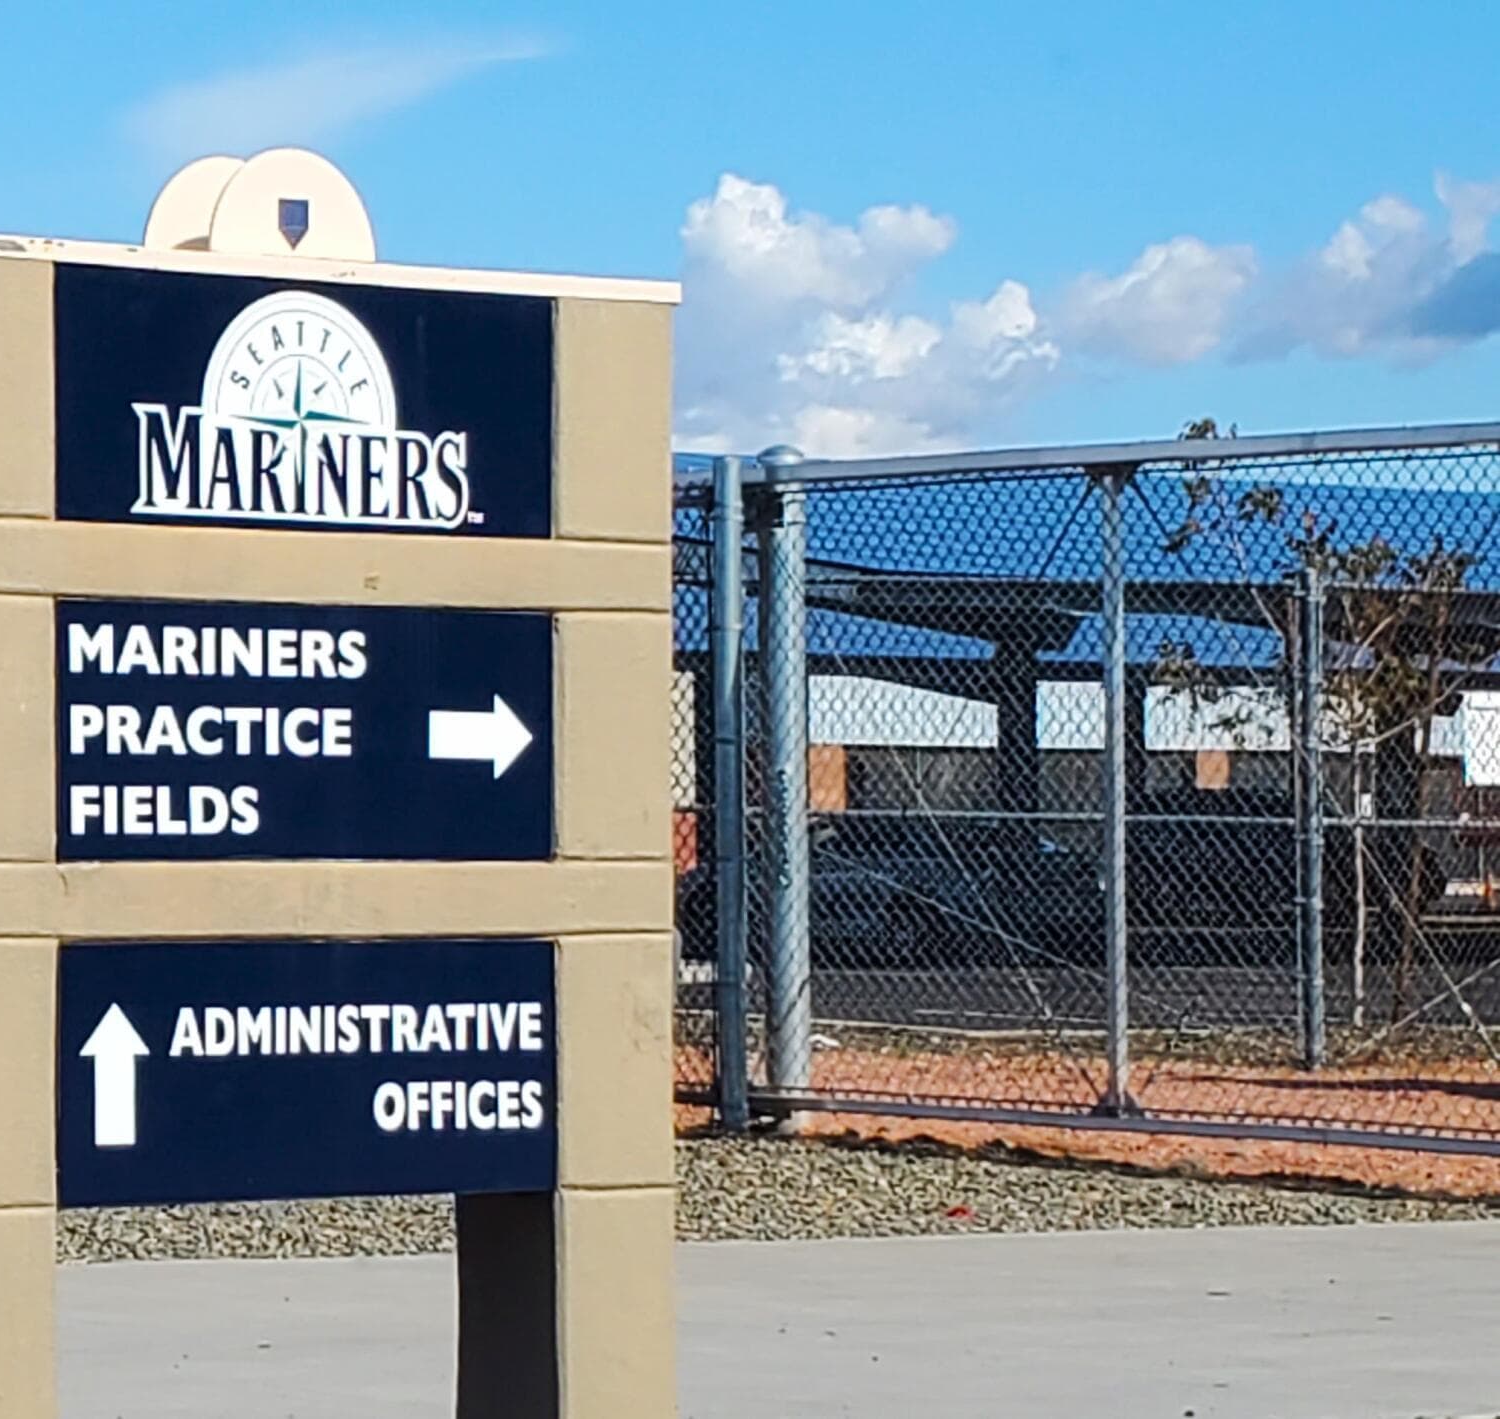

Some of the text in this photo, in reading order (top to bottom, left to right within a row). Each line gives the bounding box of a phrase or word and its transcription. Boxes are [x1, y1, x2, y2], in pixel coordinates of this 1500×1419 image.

[230, 320, 369, 395] SEATTLE
[133, 403, 469, 528] MARINERS
[68, 623, 367, 679] MARINERS
[69, 704, 352, 757] PRACTICE
[70, 785, 260, 835] FIELDS
[169, 1002, 543, 1057] ADMINISTRATIVE
[373, 1079, 544, 1132] OFFICES
